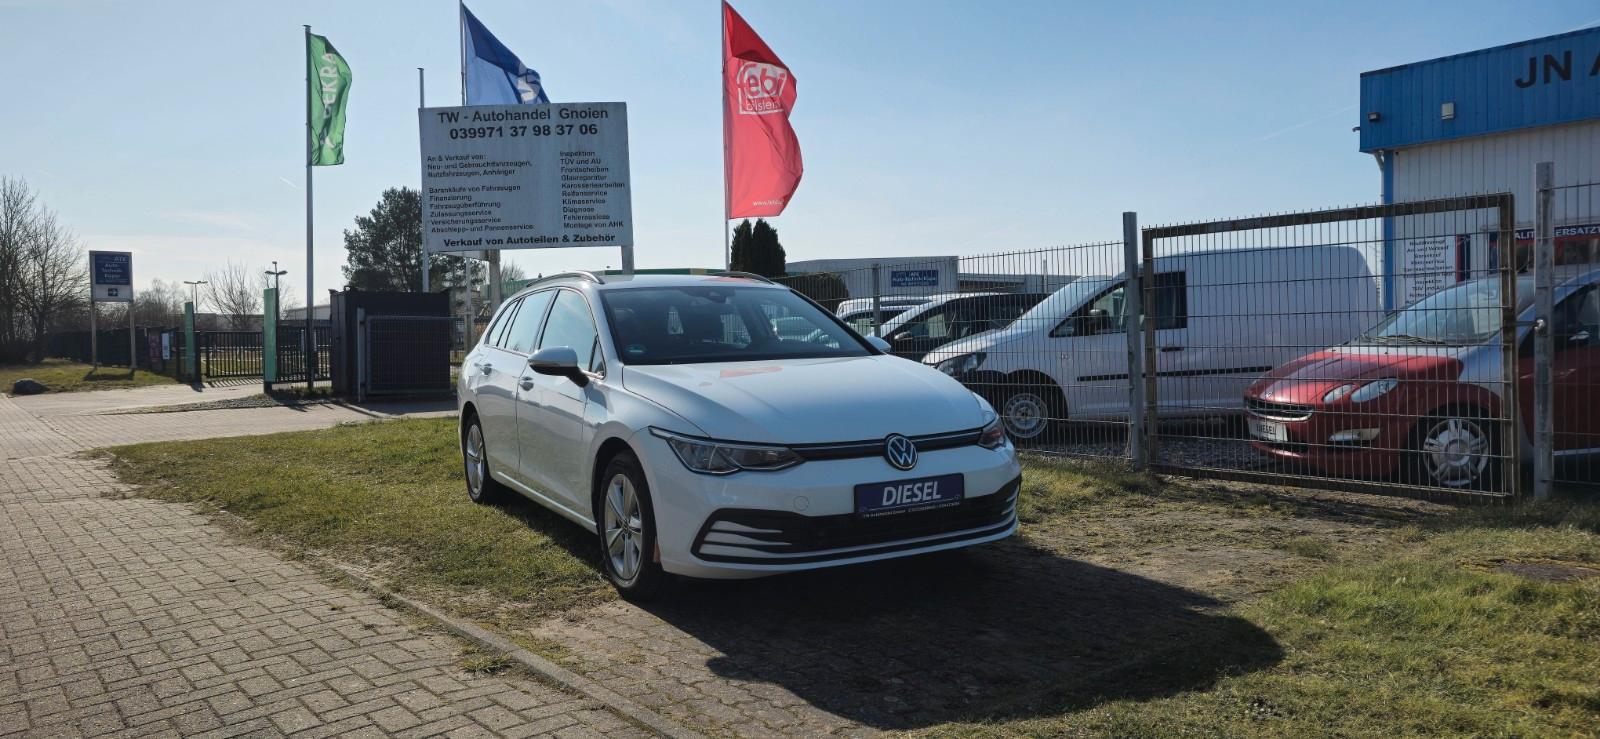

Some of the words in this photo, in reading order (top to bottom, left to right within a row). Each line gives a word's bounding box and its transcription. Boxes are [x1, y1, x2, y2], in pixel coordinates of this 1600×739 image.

[1515, 50, 1571, 88] JN
[741, 62, 785, 97] febi
[437, 112, 459, 123] TW
[472, 108, 551, 123] Autohandel
[558, 107, 609, 119] Gnoien
[449, 126, 503, 139] 039971
[510, 126, 527, 137] 37
[533, 125, 551, 136] 98
[556, 124, 572, 135] 37
[581, 123, 598, 135] 06
[560, 157, 575, 165] TÜV
[444, 237, 481, 247] Verkauf
[506, 235, 559, 245] Autoteilen
[562, 235, 569, 243] &
[573, 233, 616, 243] Zubehör
[881, 480, 942, 506] DIESEL
